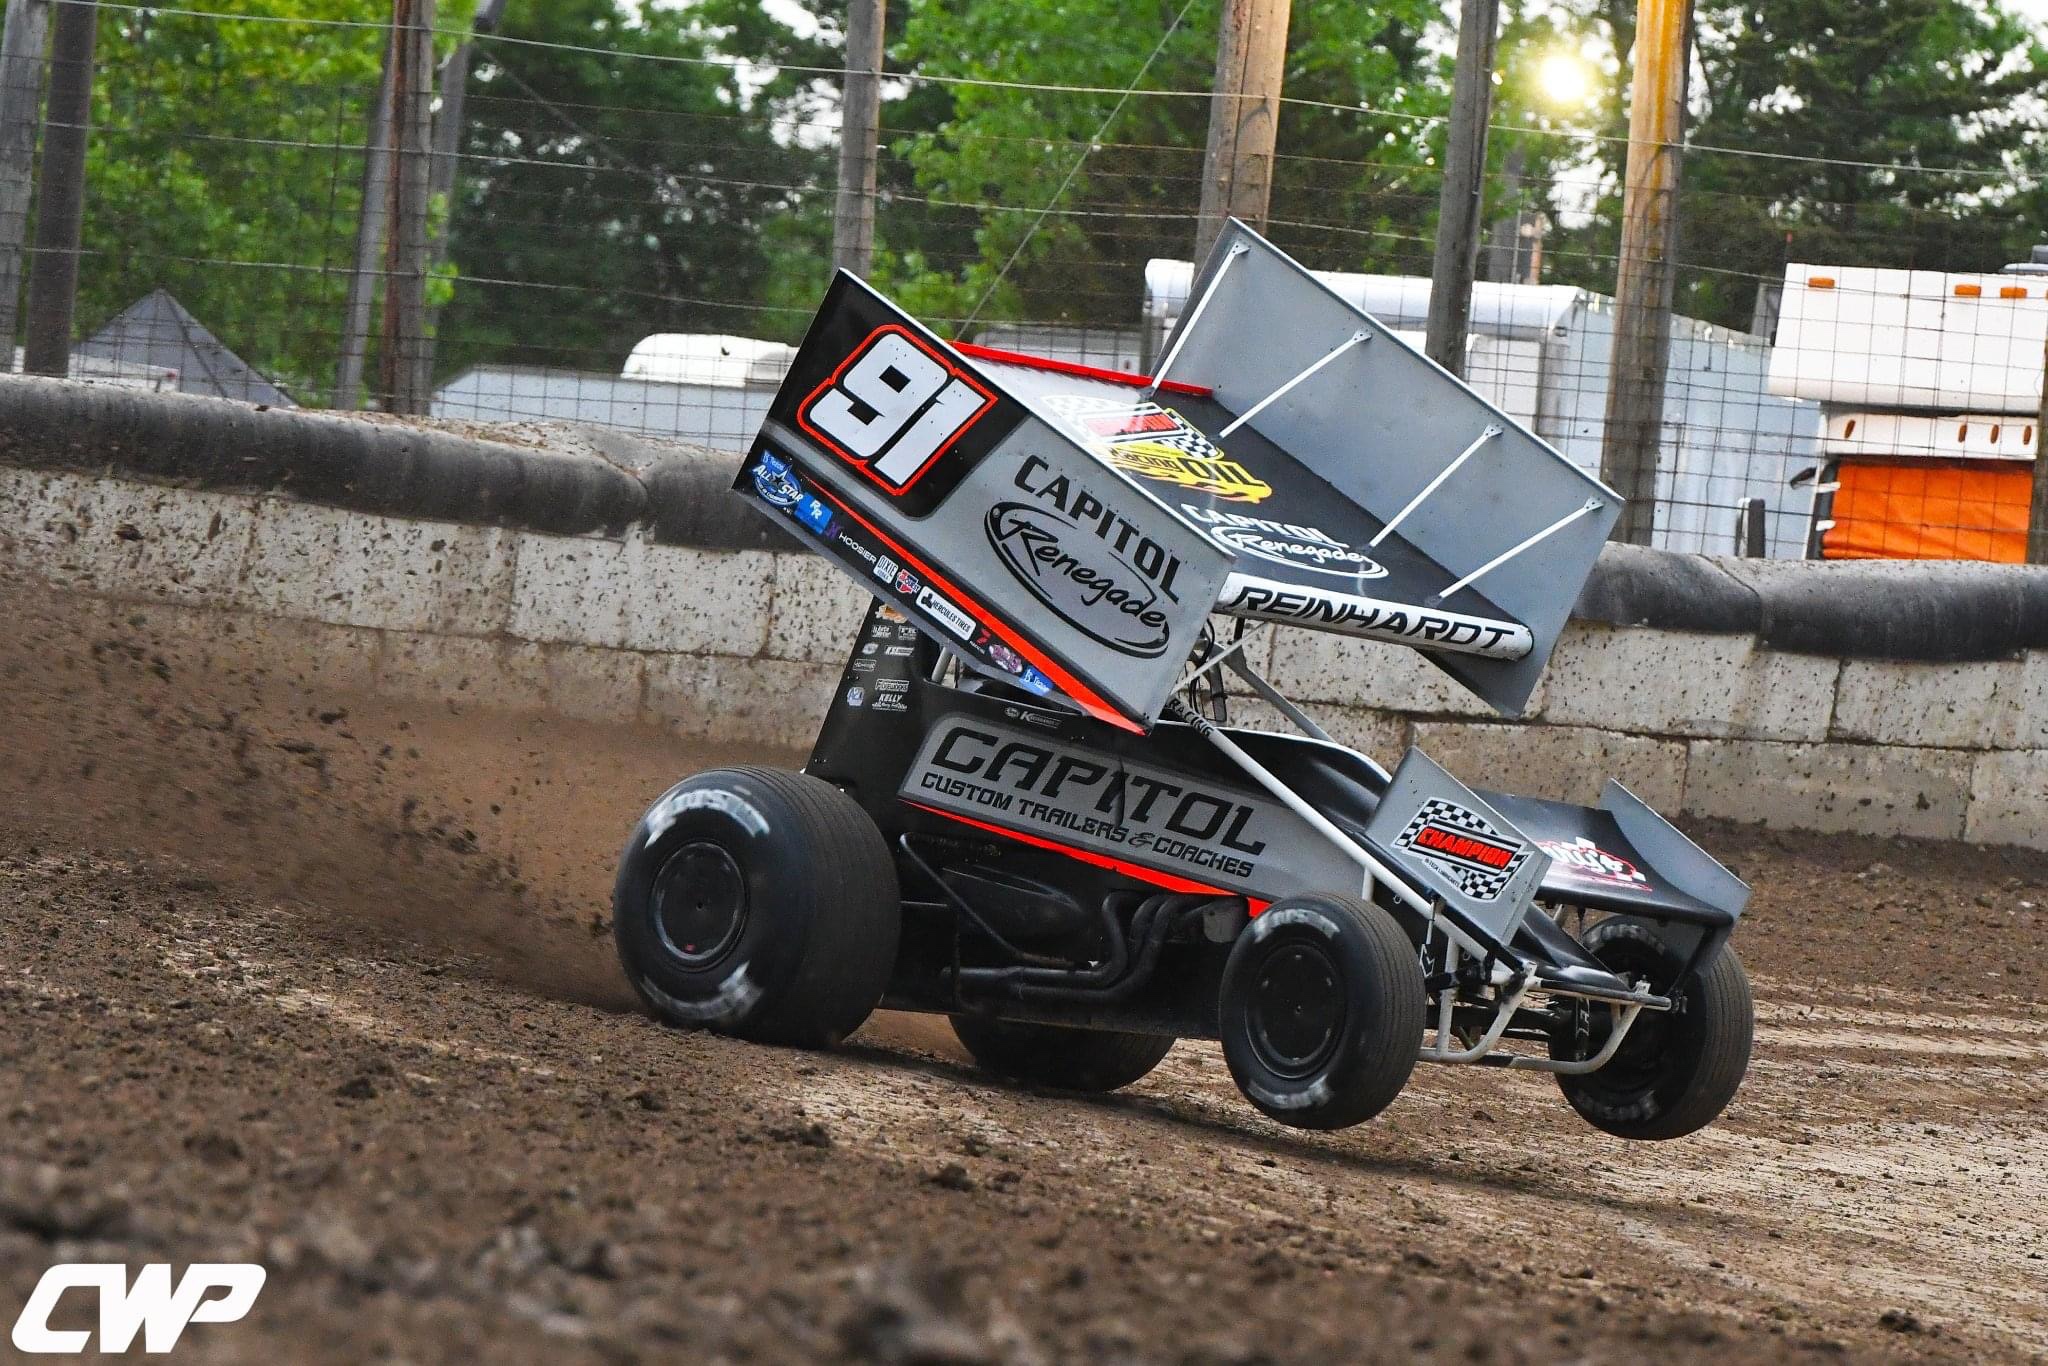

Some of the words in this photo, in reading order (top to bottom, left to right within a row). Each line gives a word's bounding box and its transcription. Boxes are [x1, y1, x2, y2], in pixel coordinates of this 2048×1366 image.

[809, 333, 987, 487] 91
[752, 464, 773, 481] ALL
[777, 484, 804, 502] STAR
[1176, 457, 1266, 488] OIL
[1014, 454, 1181, 605] CAPITOL
[1180, 503, 1350, 549] CAPITOL
[838, 531, 878, 566] HOOSIER
[876, 556, 898, 578] DIXIE
[1226, 532, 1363, 565] Renegade
[999, 517, 1167, 628] Renegade
[931, 599, 957, 623] HERCULES
[954, 617, 971, 633] TIRES
[1230, 585, 1516, 649] REINHARDT
[878, 693, 903, 703] KELLY
[931, 726, 1266, 856] CAPITOL
[921, 771, 1023, 811] CUSTOM
[1019, 798, 1130, 843] TRAILERS
[1128, 832, 1156, 849] &
[1151, 836, 1255, 878] COACHES
[1416, 827, 1514, 868] CHAMPION
